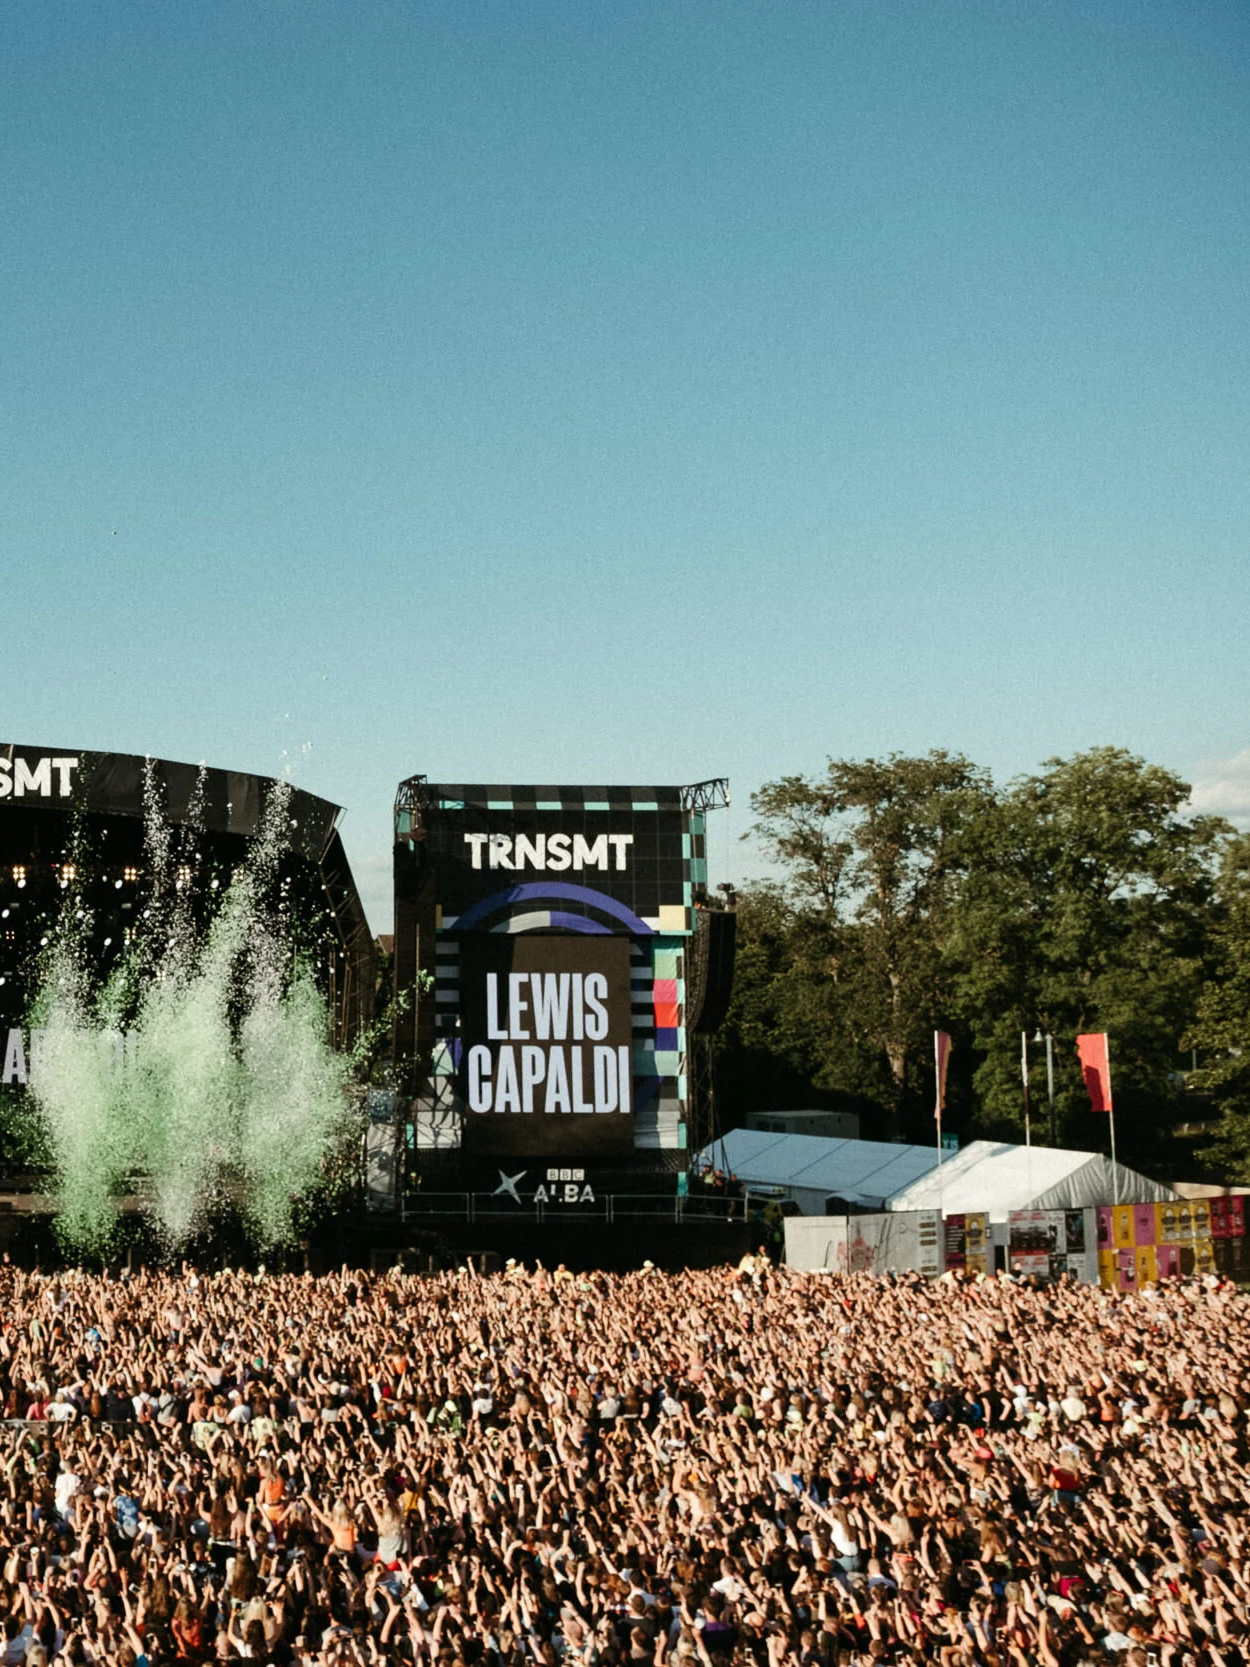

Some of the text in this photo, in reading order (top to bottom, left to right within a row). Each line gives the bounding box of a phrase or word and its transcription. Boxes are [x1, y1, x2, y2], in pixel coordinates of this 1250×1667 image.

[464, 833, 633, 870] TRNSMT
[486, 972, 608, 1040] LEWIS
[468, 1044, 630, 1113] CAPALDI
[547, 1169, 584, 1180] BBC
